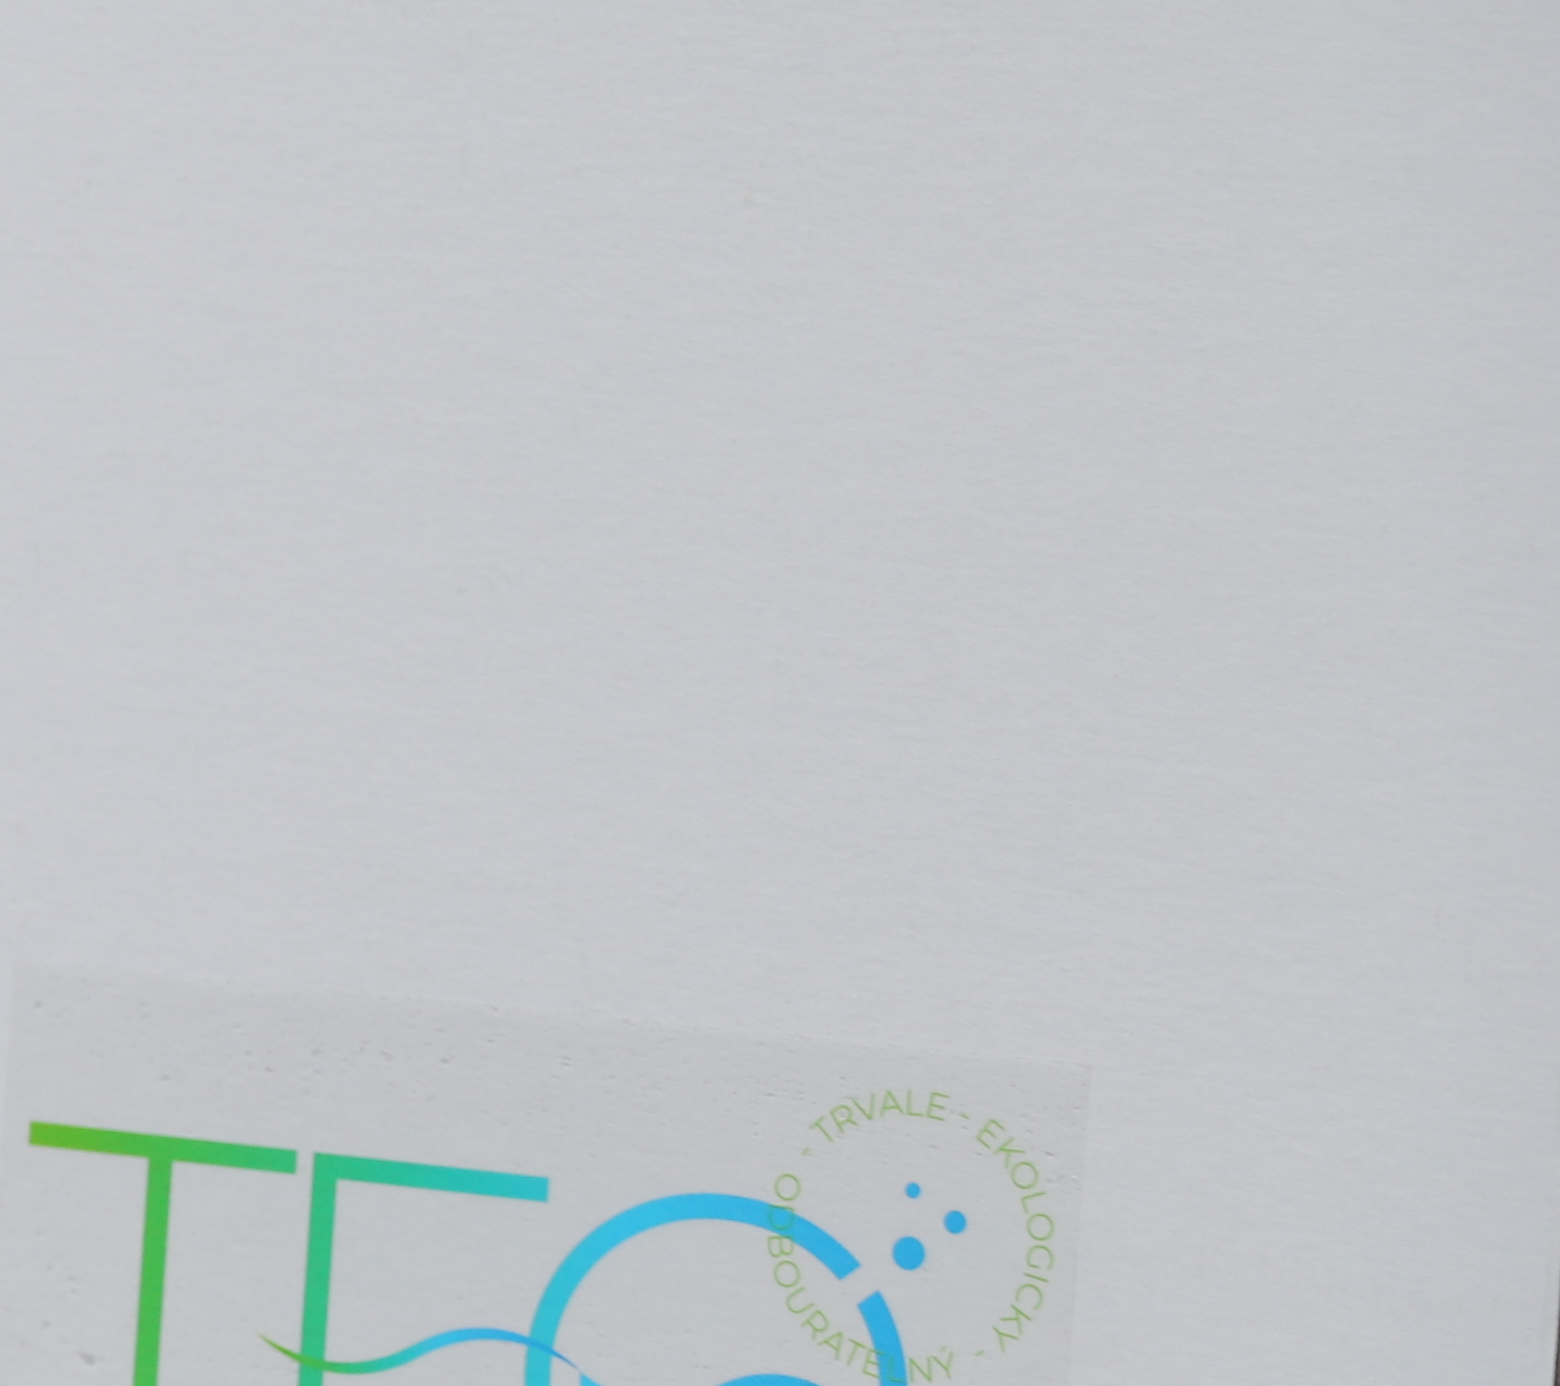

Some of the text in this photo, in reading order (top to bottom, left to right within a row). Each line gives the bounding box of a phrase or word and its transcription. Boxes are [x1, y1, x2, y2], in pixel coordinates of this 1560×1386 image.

[766, 1088, 1056, 1385] TRVALE EKOLOGICKY ODBOURATELNÝ
